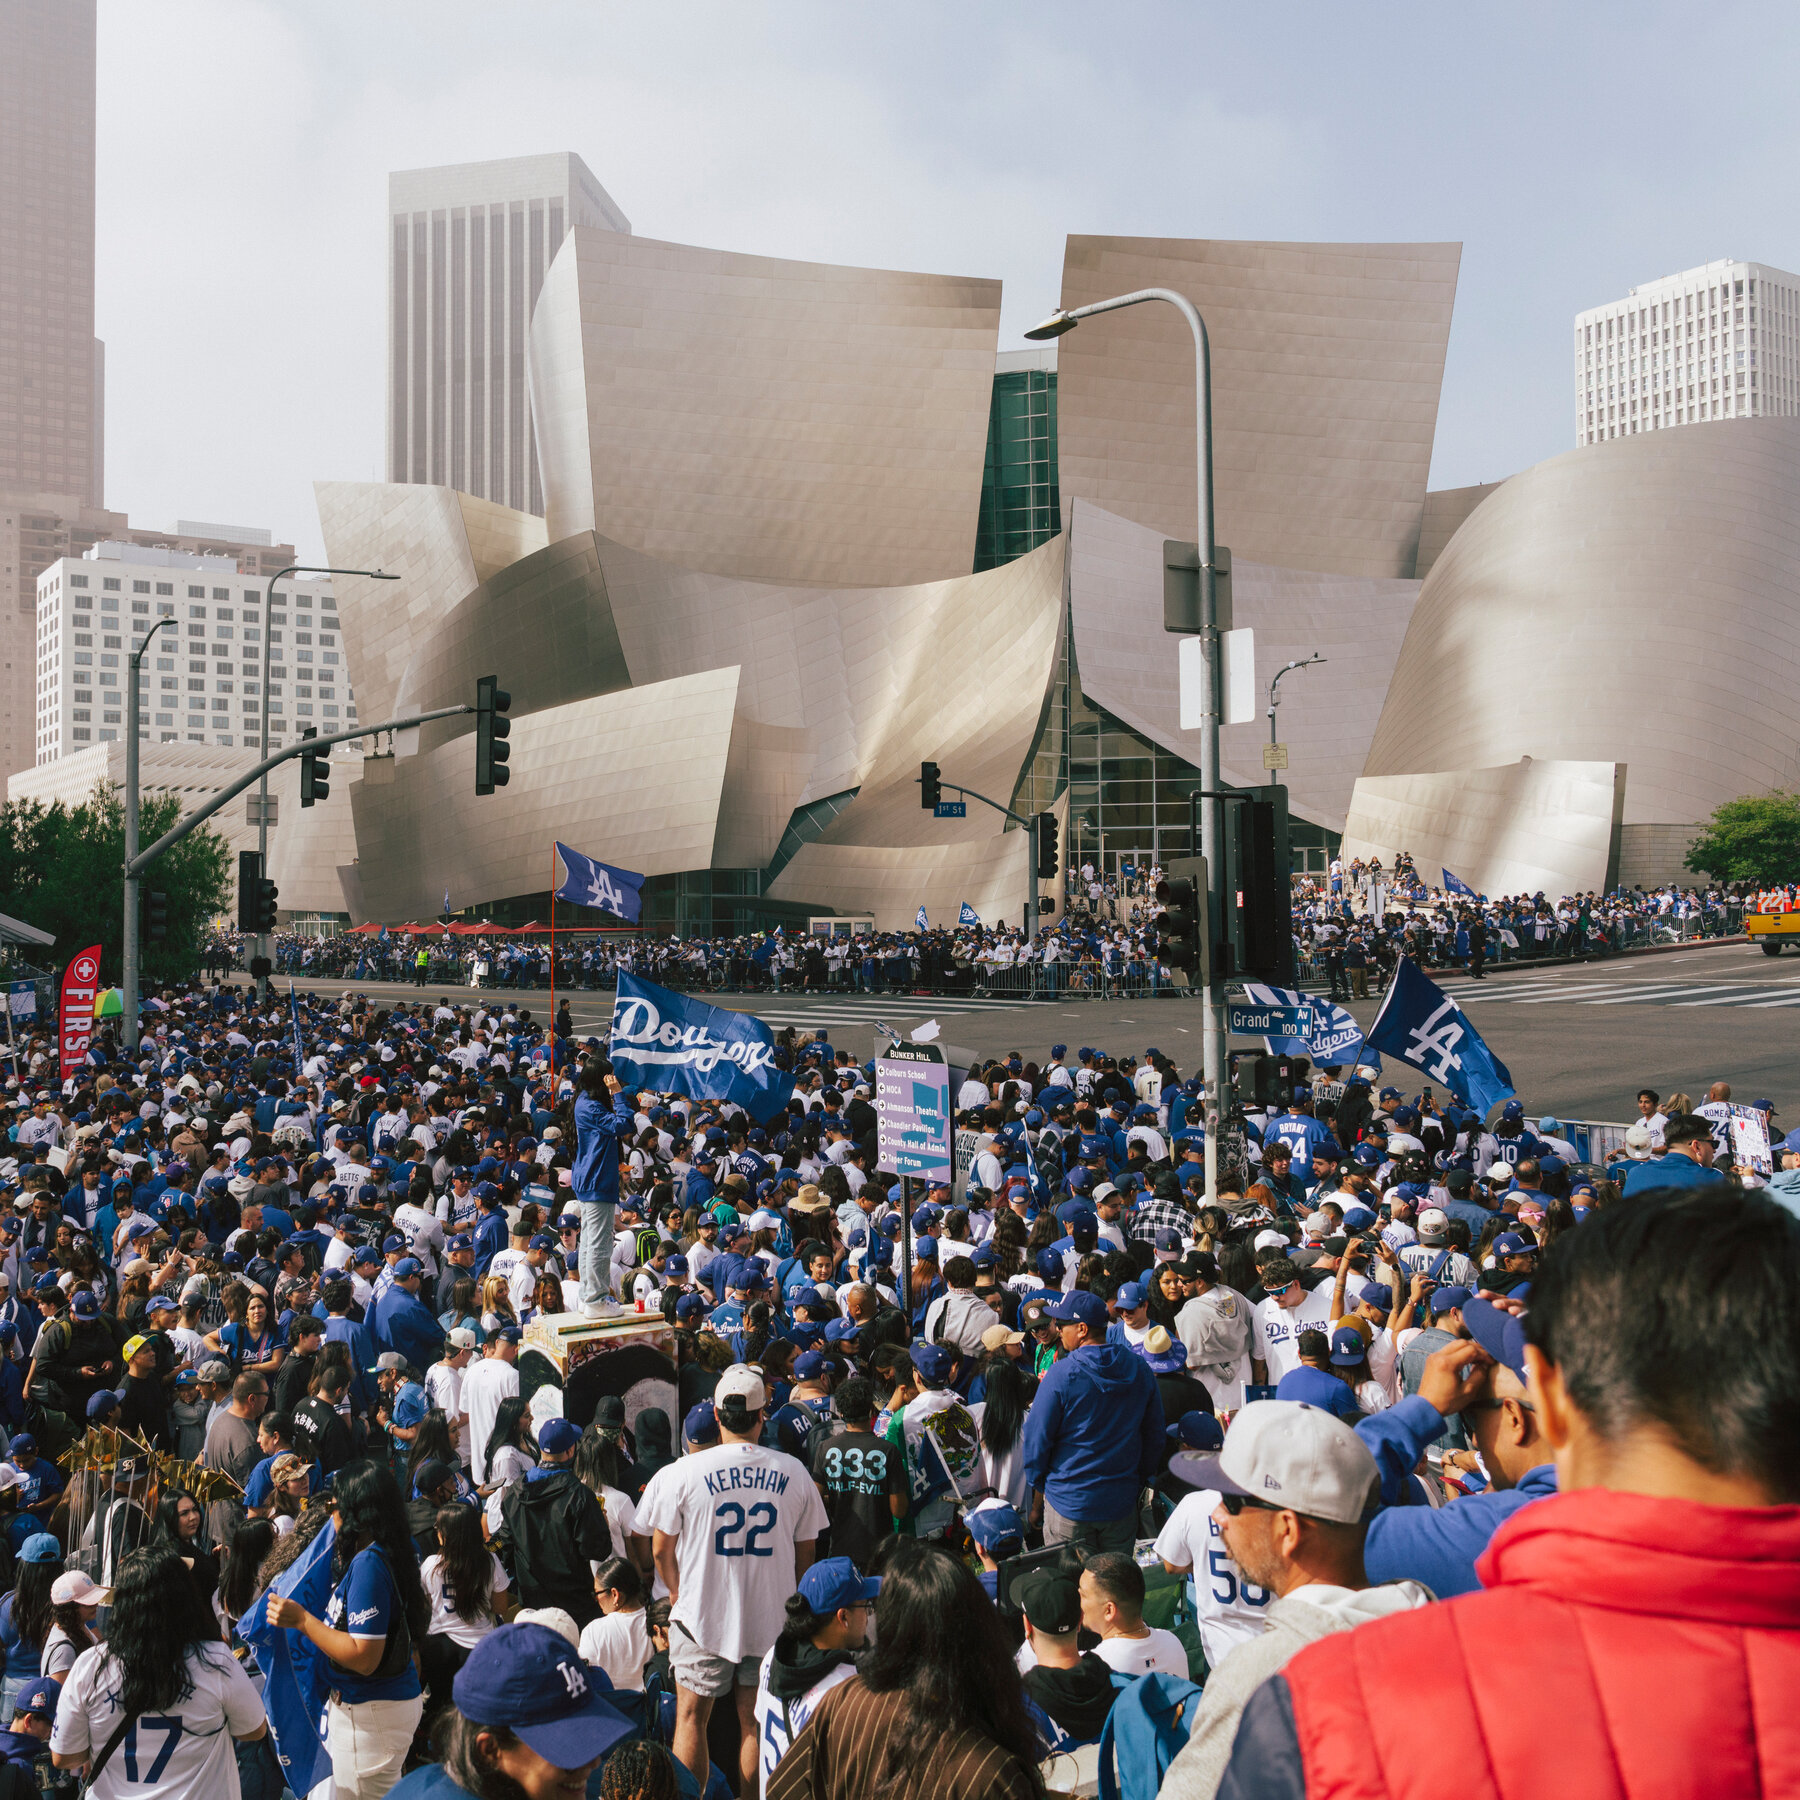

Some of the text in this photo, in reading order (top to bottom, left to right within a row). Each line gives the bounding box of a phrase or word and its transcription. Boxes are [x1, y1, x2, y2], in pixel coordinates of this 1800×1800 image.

[938, 804, 962, 815] 1st St
[64, 987, 95, 1067] FIRST
[1233, 1009, 1309, 1028] Grand Av
[1281, 1024, 1309, 1036] 100 N
[1404, 993, 1465, 1085] LA
[890, 1050, 931, 1062] BUNKER HILL
[885, 1067, 927, 1080] Colburn School
[886, 1085, 902, 1095] MOCA
[1327, 1085, 1342, 1099] RULE
[886, 1103, 938, 1117] Ahmanson Theatre
[886, 1119, 935, 1134] Chandler Pavilion
[1279, 1123, 1307, 1135] BRYANT
[887, 1136, 946, 1153] County Hall of Admin
[888, 1154, 922, 1168] Taper Forum
[1500, 1145, 1518, 1164] 10
[339, 1173, 360, 1183] BETTS
[1408, 1253, 1424, 1273] WE
[1265, 1319, 1328, 1339] Dodgers
[242, 1348, 272, 1362] Doders
[824, 1447, 887, 1481] 333
[704, 1467, 790, 1497] KERSHAW
[826, 1480, 884, 1496] HALF-EVIL
[714, 1501, 778, 1557] 22
[349, 1606, 380, 1626] Dodgers
[556, 1661, 588, 1699] LA
[104, 1682, 196, 1714] 大平
[124, 1715, 183, 1784] 17
